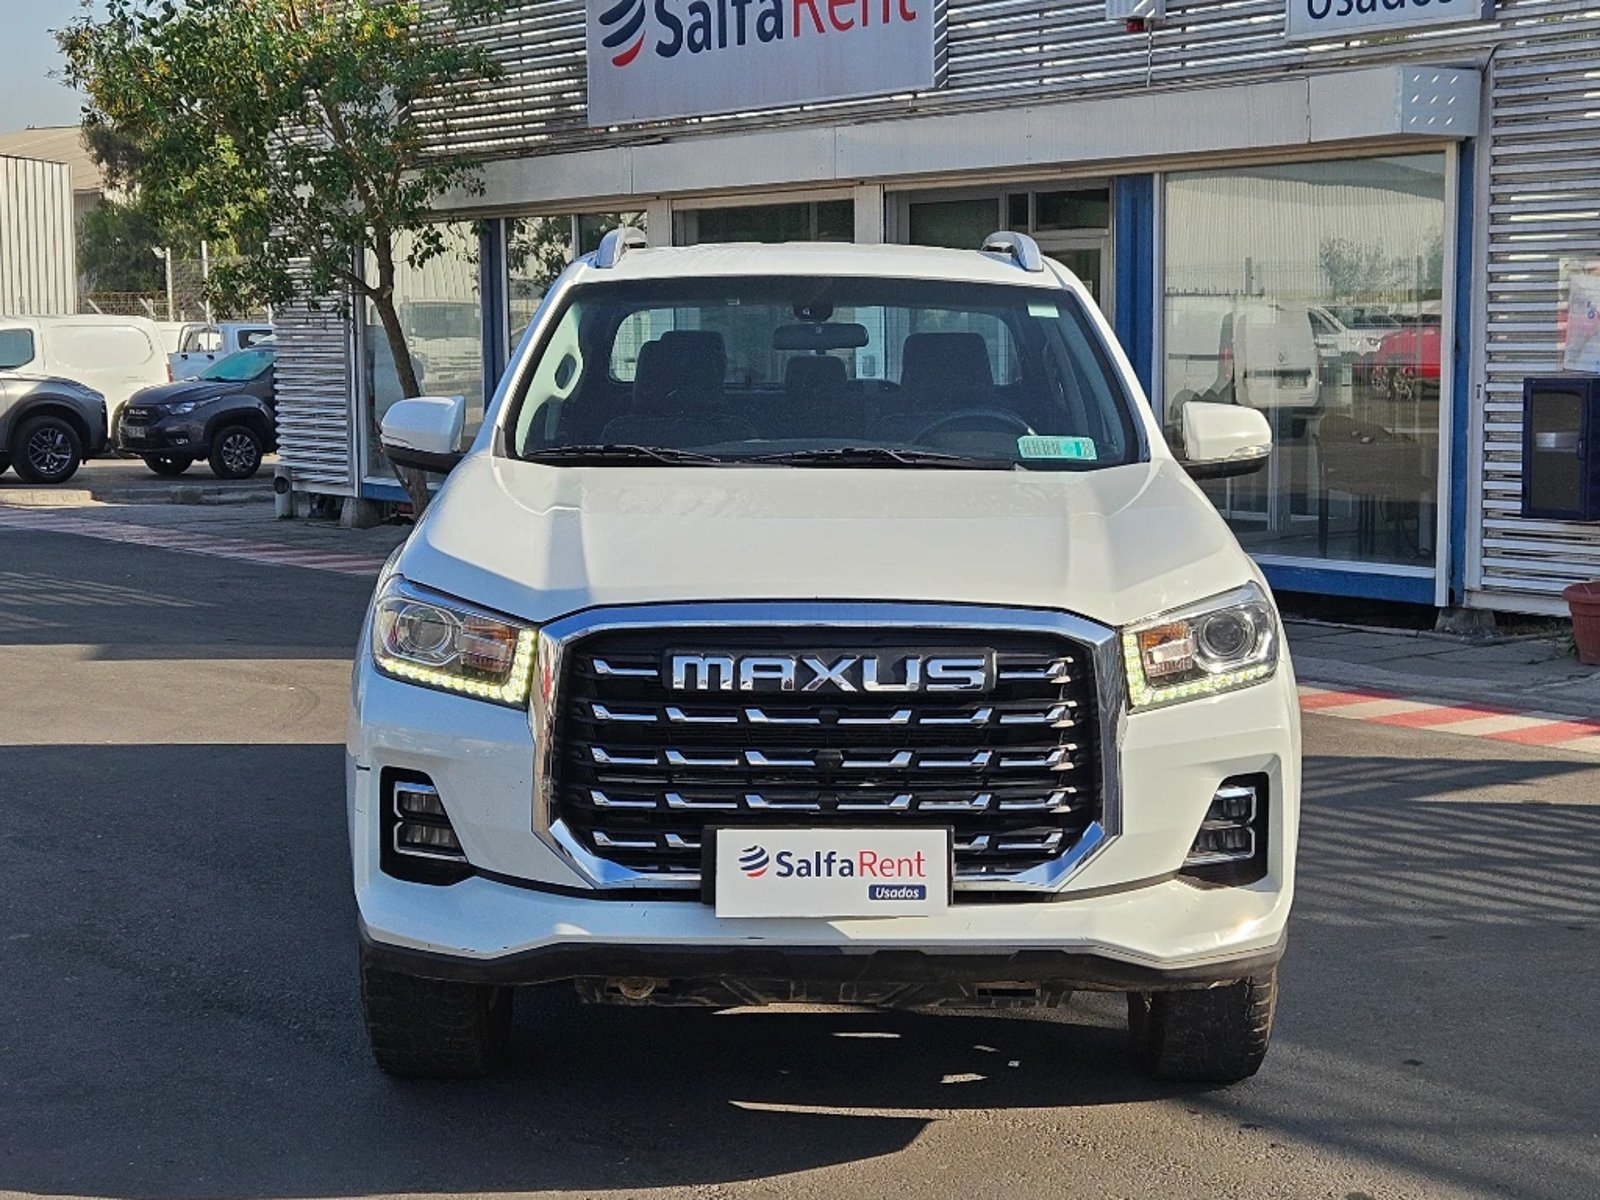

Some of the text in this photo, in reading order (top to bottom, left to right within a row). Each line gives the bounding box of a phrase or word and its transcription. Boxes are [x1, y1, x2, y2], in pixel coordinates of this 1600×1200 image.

[1307, 0, 1450, 19] Usa
[673, 655, 986, 692] MAXUS
[775, 851, 926, 878] SalfaRent
[875, 887, 920, 899] Usados
